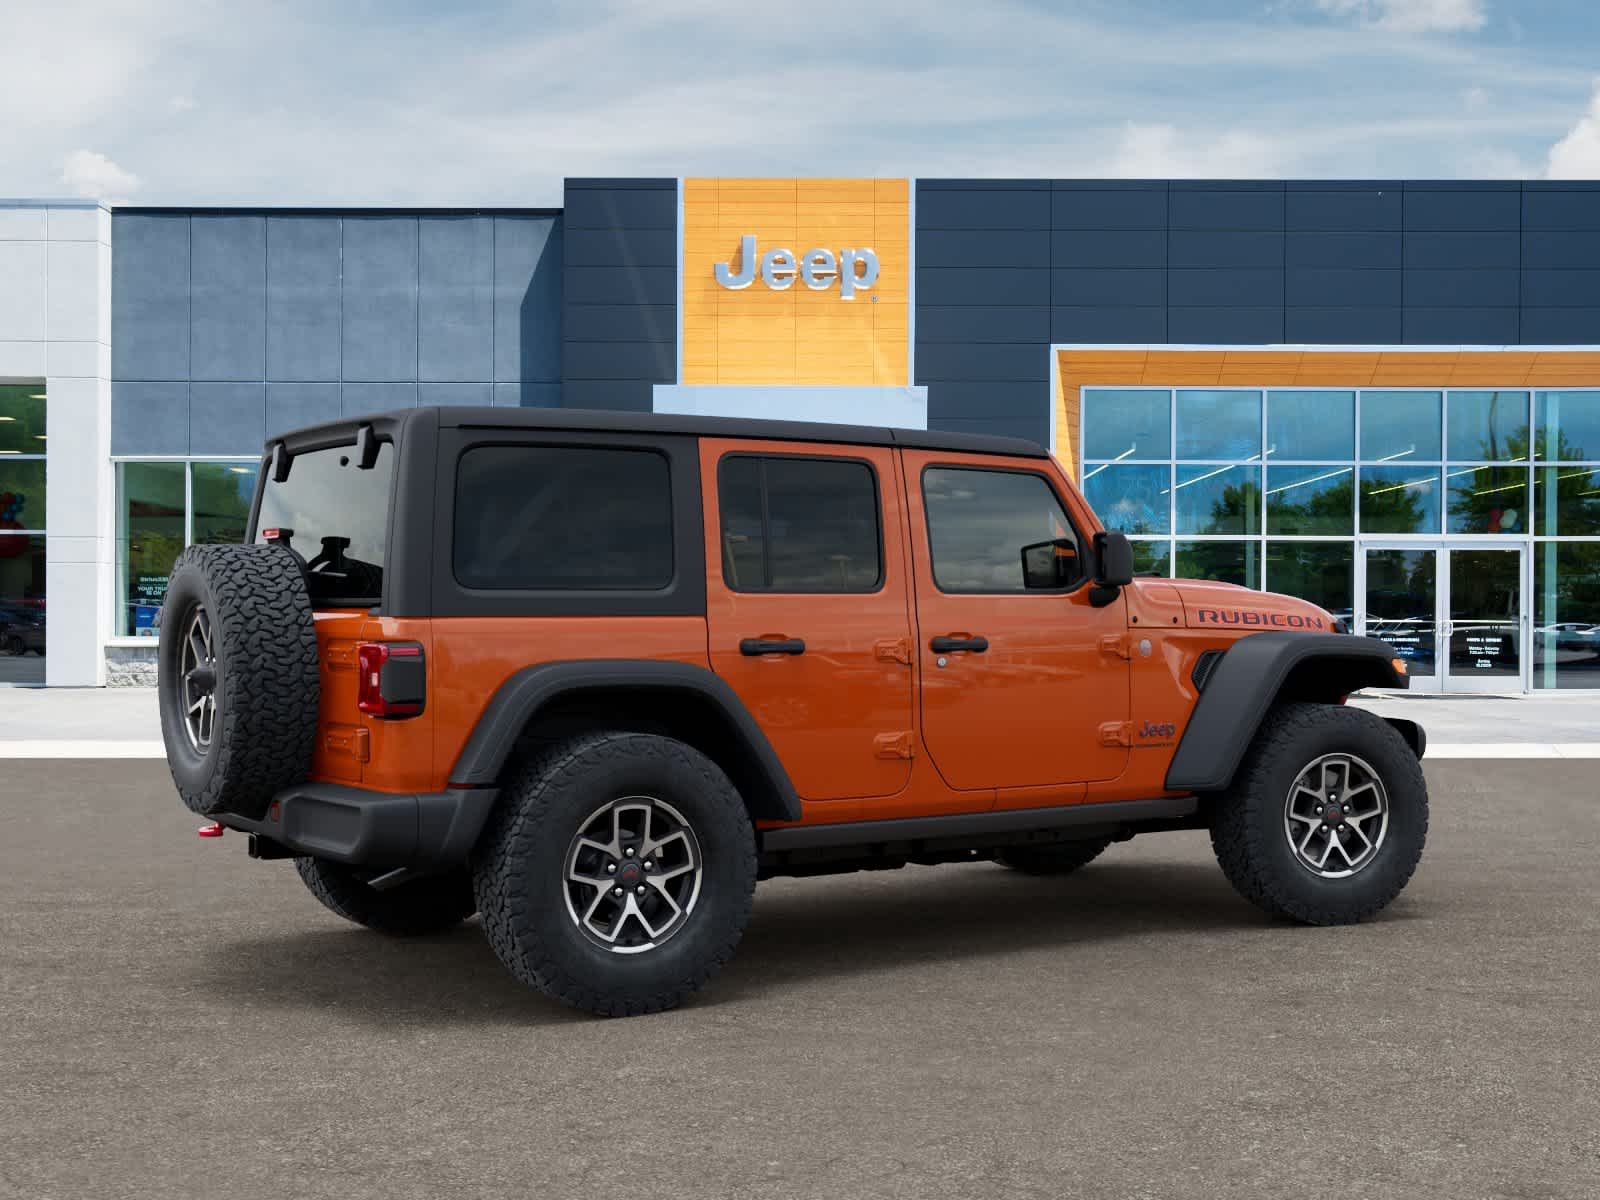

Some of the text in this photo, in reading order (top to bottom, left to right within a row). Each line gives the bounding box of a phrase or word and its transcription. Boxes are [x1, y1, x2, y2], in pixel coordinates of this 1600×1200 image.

[713, 234, 881, 300] Jeep
[1198, 609, 1324, 629] RUBICON
[1139, 719, 1176, 738] Jeep
